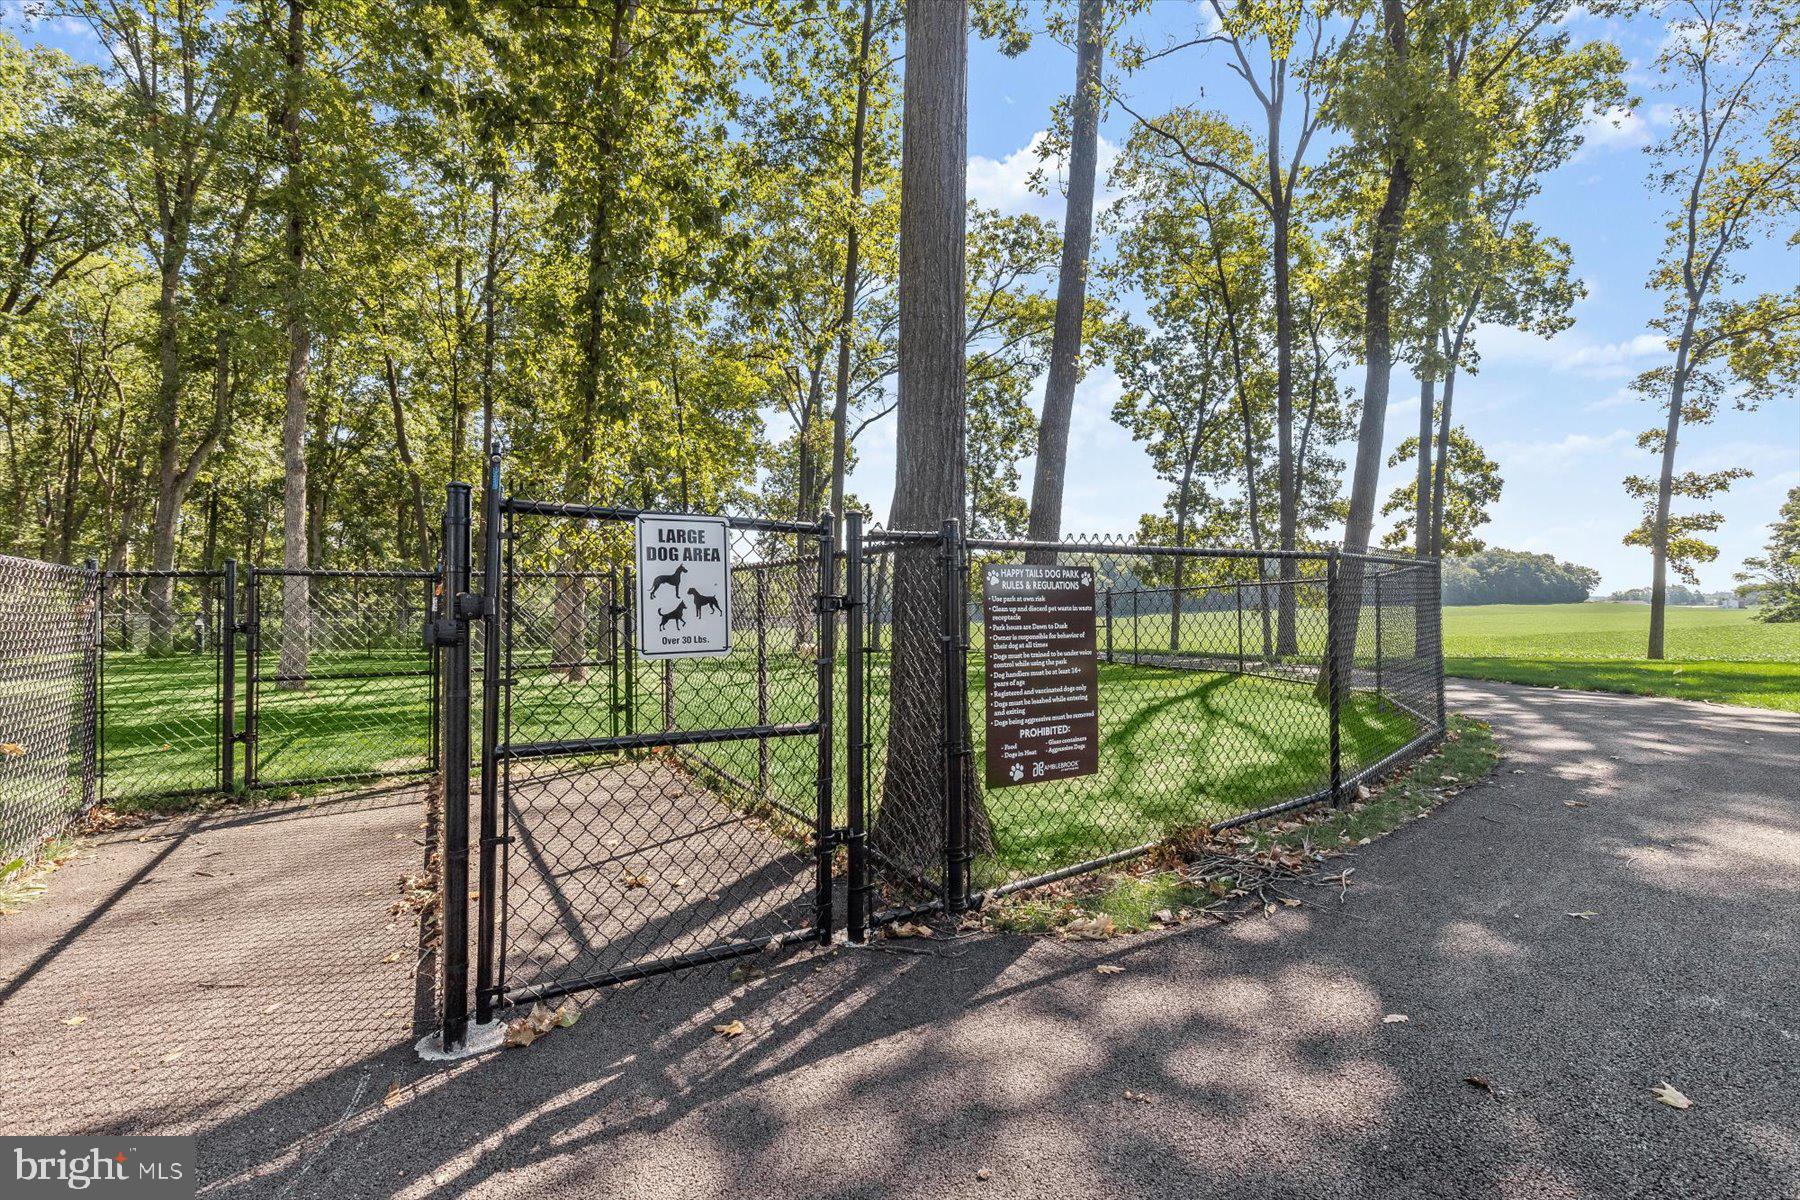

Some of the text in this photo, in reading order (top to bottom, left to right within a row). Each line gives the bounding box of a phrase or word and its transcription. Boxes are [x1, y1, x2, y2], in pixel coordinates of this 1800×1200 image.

[658, 529, 705, 544] LARGE
[647, 547, 720, 562] DOG AREA
[1001, 569, 1023, 577] HAPPY
[1026, 569, 1043, 578] TAILS
[1045, 570, 1060, 578] DOG
[1002, 581, 1023, 589] RULES
[1018, 633, 1048, 641] responsible
[994, 689, 1023, 698] Registered
[1025, 715, 1051, 724] aggressive
[1020, 725, 1070, 738] PROHIBITED:
[1048, 746, 1073, 754] Aggressive
[1044, 761, 1078, 770] AMBLEBROOK
